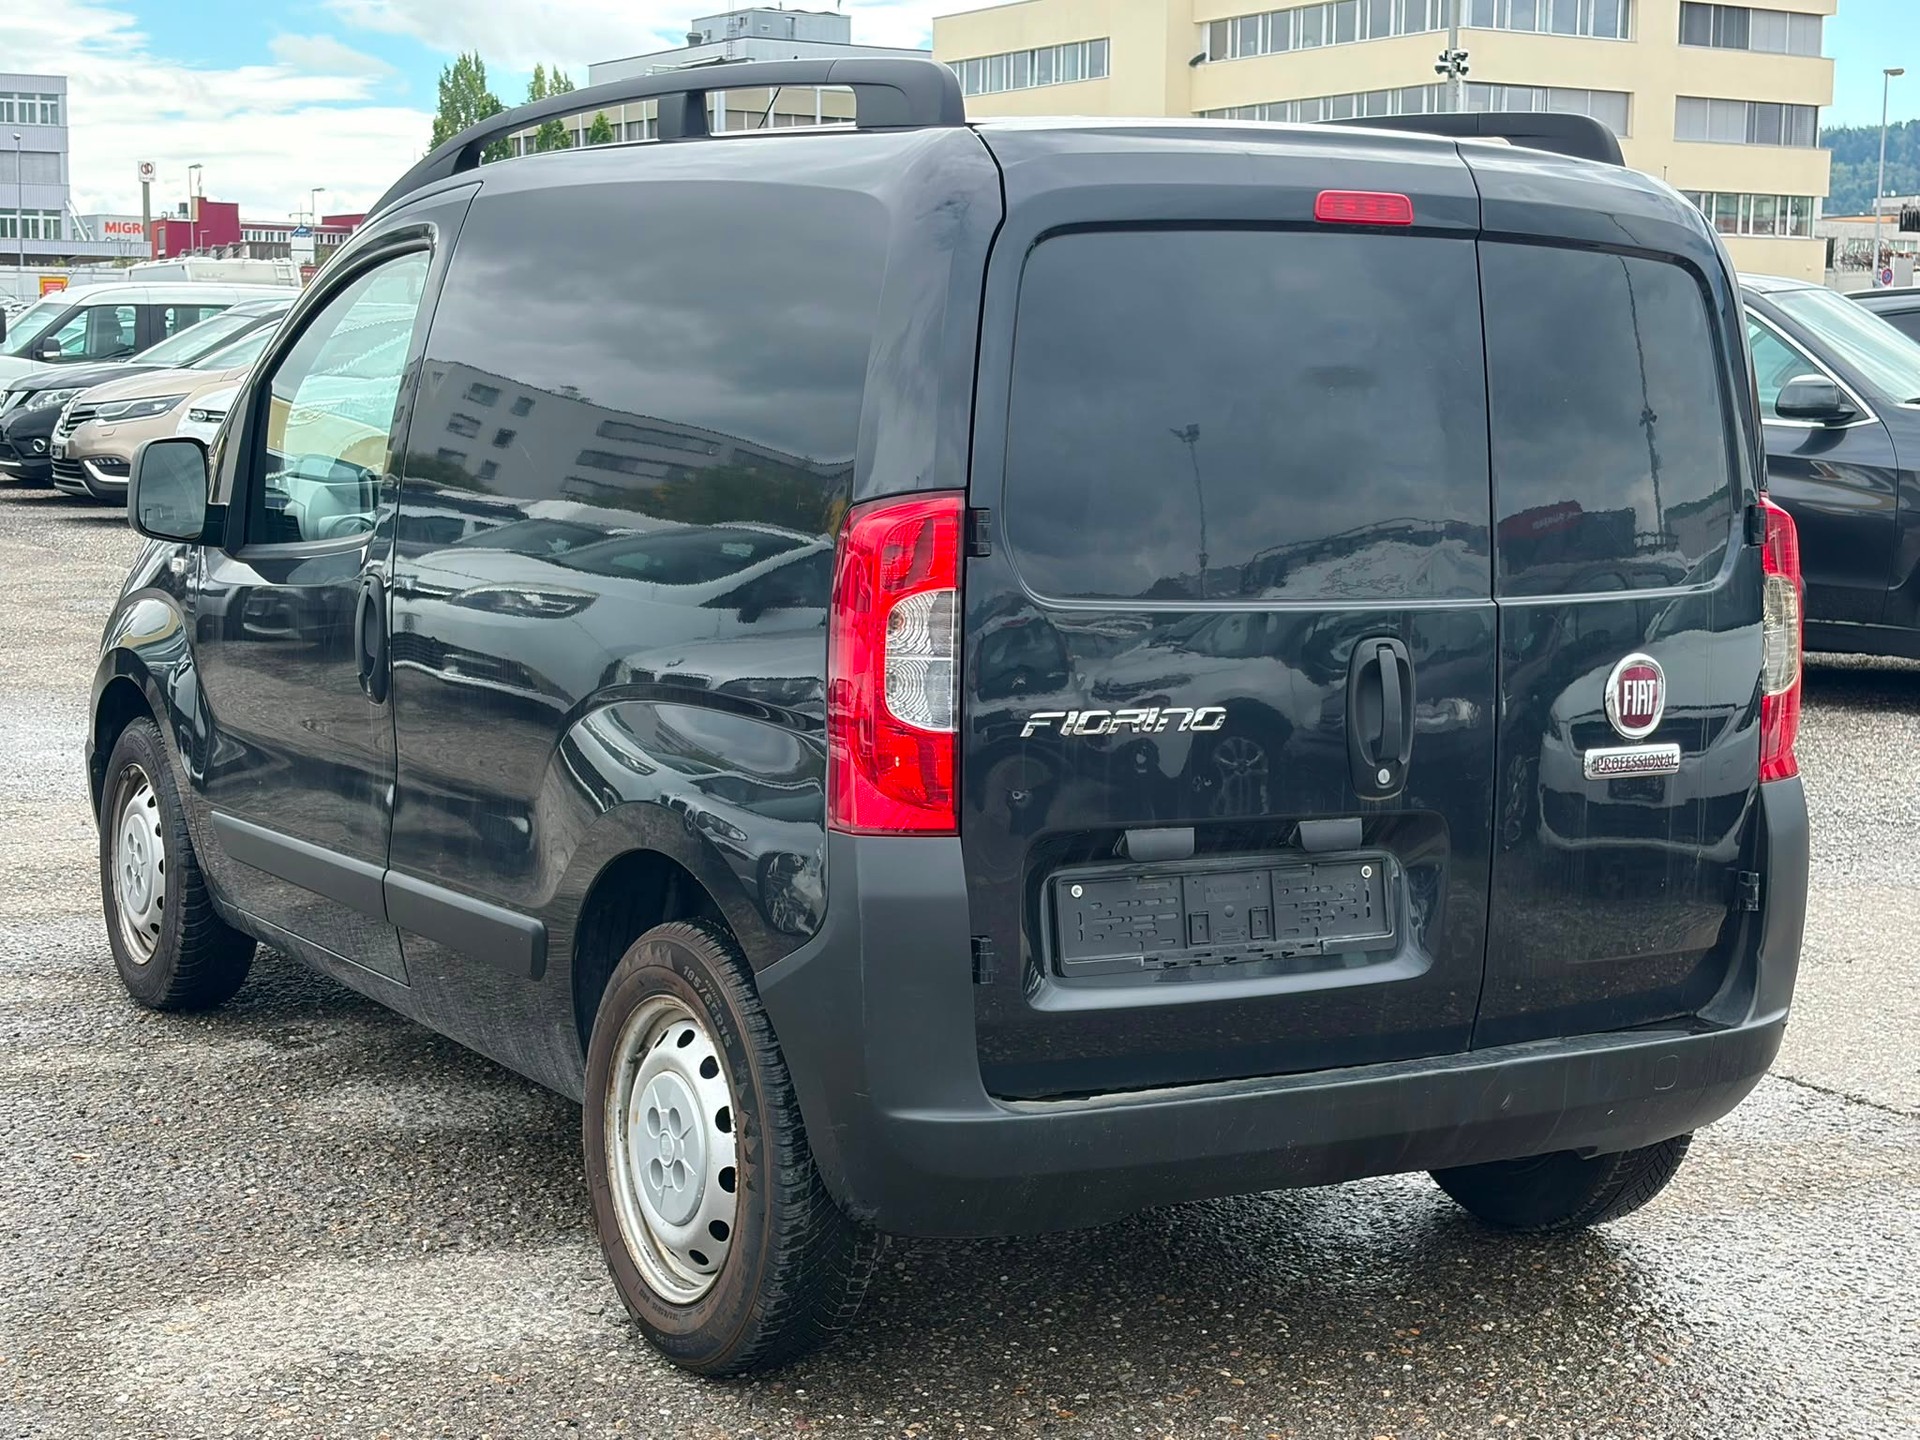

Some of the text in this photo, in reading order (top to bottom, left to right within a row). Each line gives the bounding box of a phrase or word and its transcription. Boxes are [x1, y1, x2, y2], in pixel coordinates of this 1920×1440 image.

[104, 221, 144, 234] MIGR
[1623, 679, 1656, 716] FIAT
[1019, 706, 1228, 738] FIORINO
[1596, 752, 1679, 772] PROFESSIONAL
